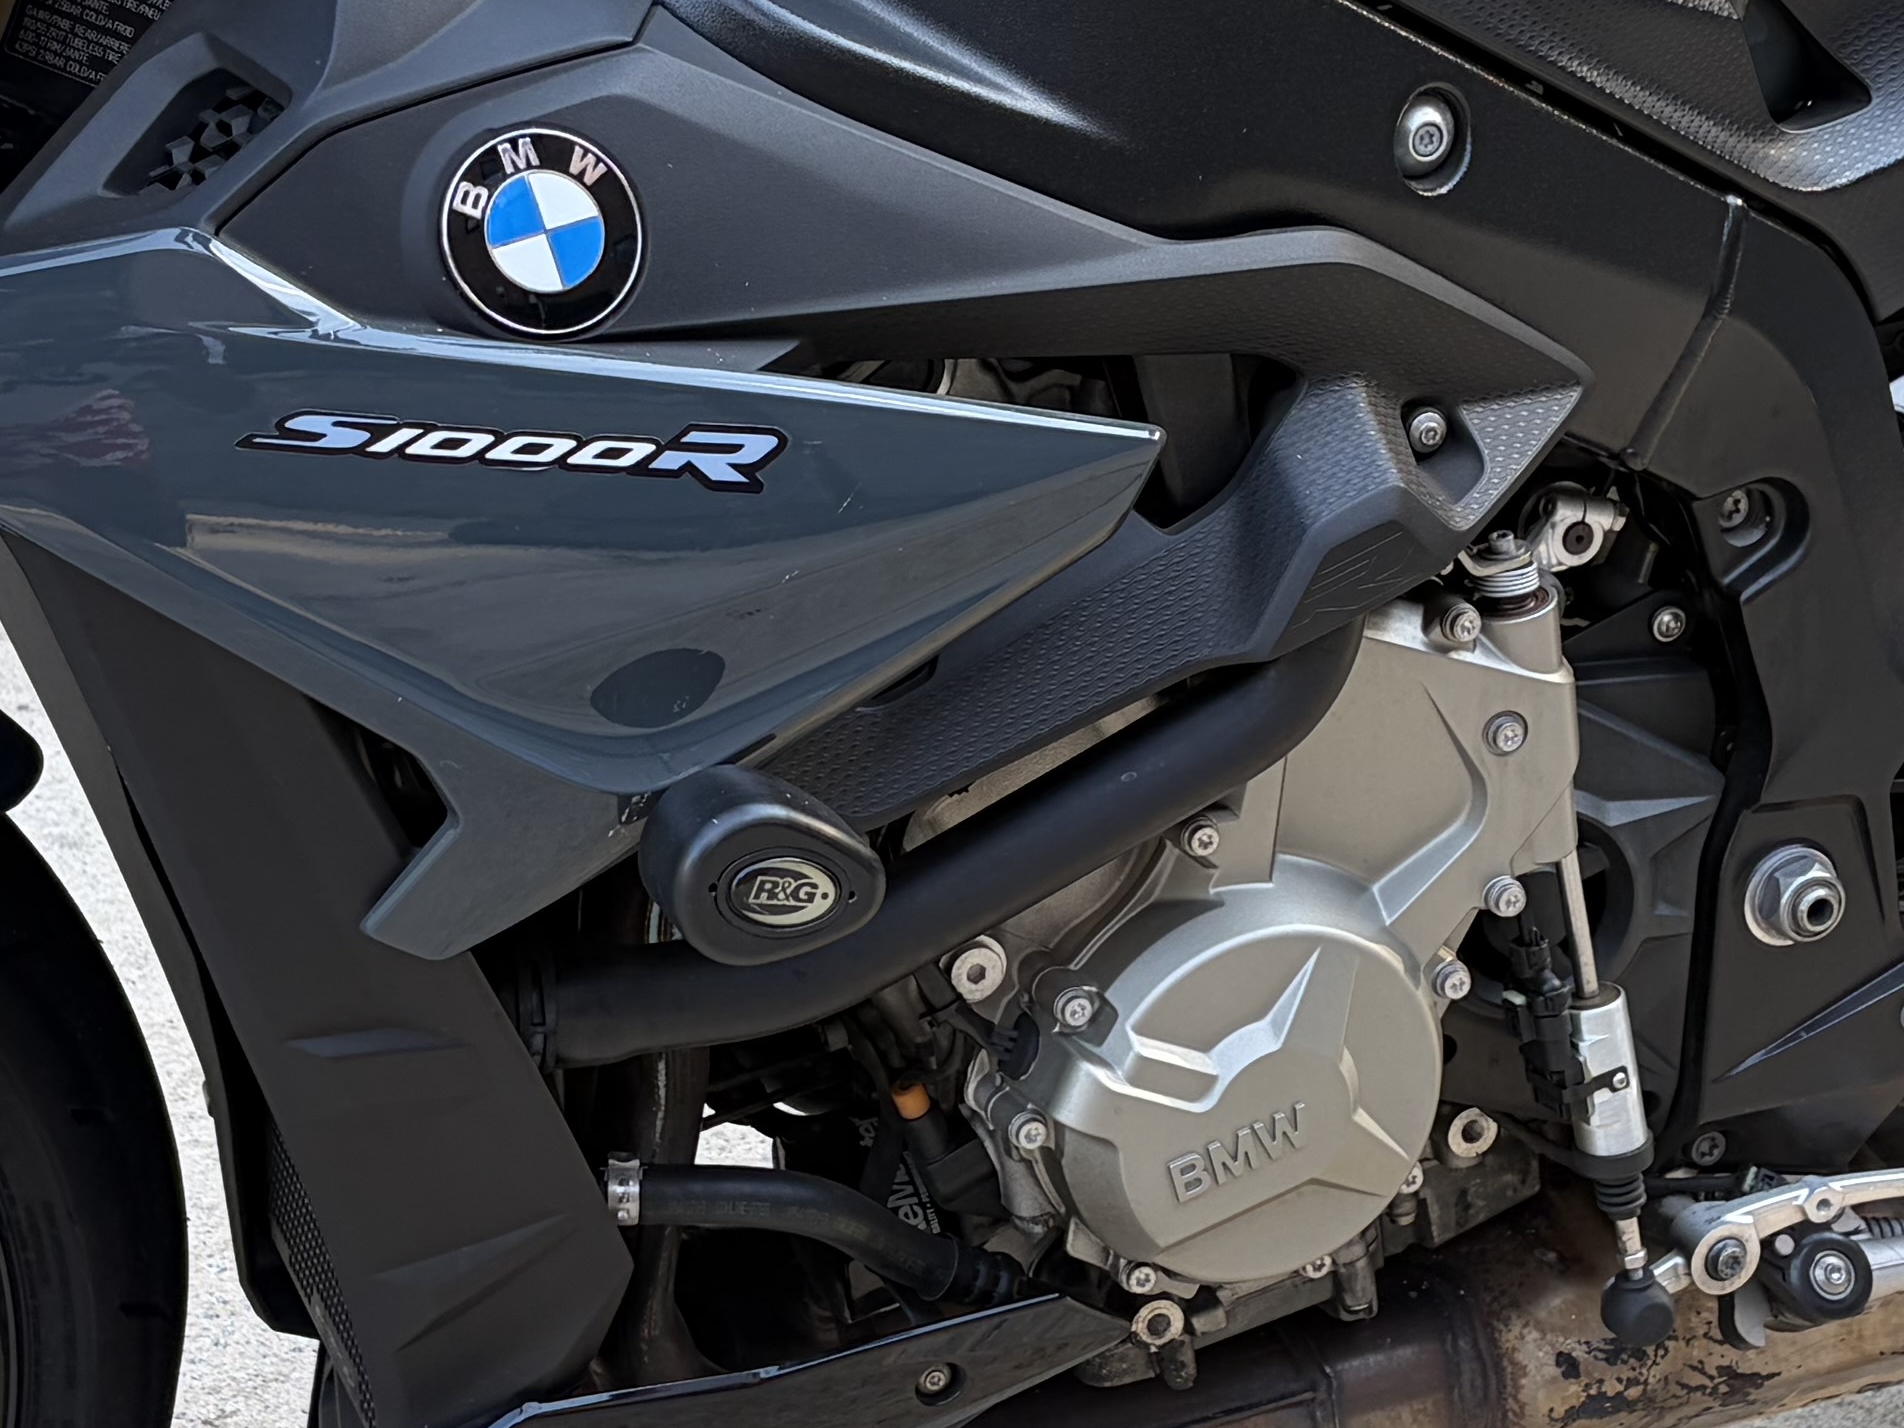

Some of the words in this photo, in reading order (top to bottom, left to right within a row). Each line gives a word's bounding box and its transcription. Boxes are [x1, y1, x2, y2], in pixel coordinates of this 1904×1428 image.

[452, 136, 607, 220] BMW
[241, 411, 785, 489] S1000R
[751, 874, 820, 905] R&G
[1168, 1101, 1306, 1203] BMW
